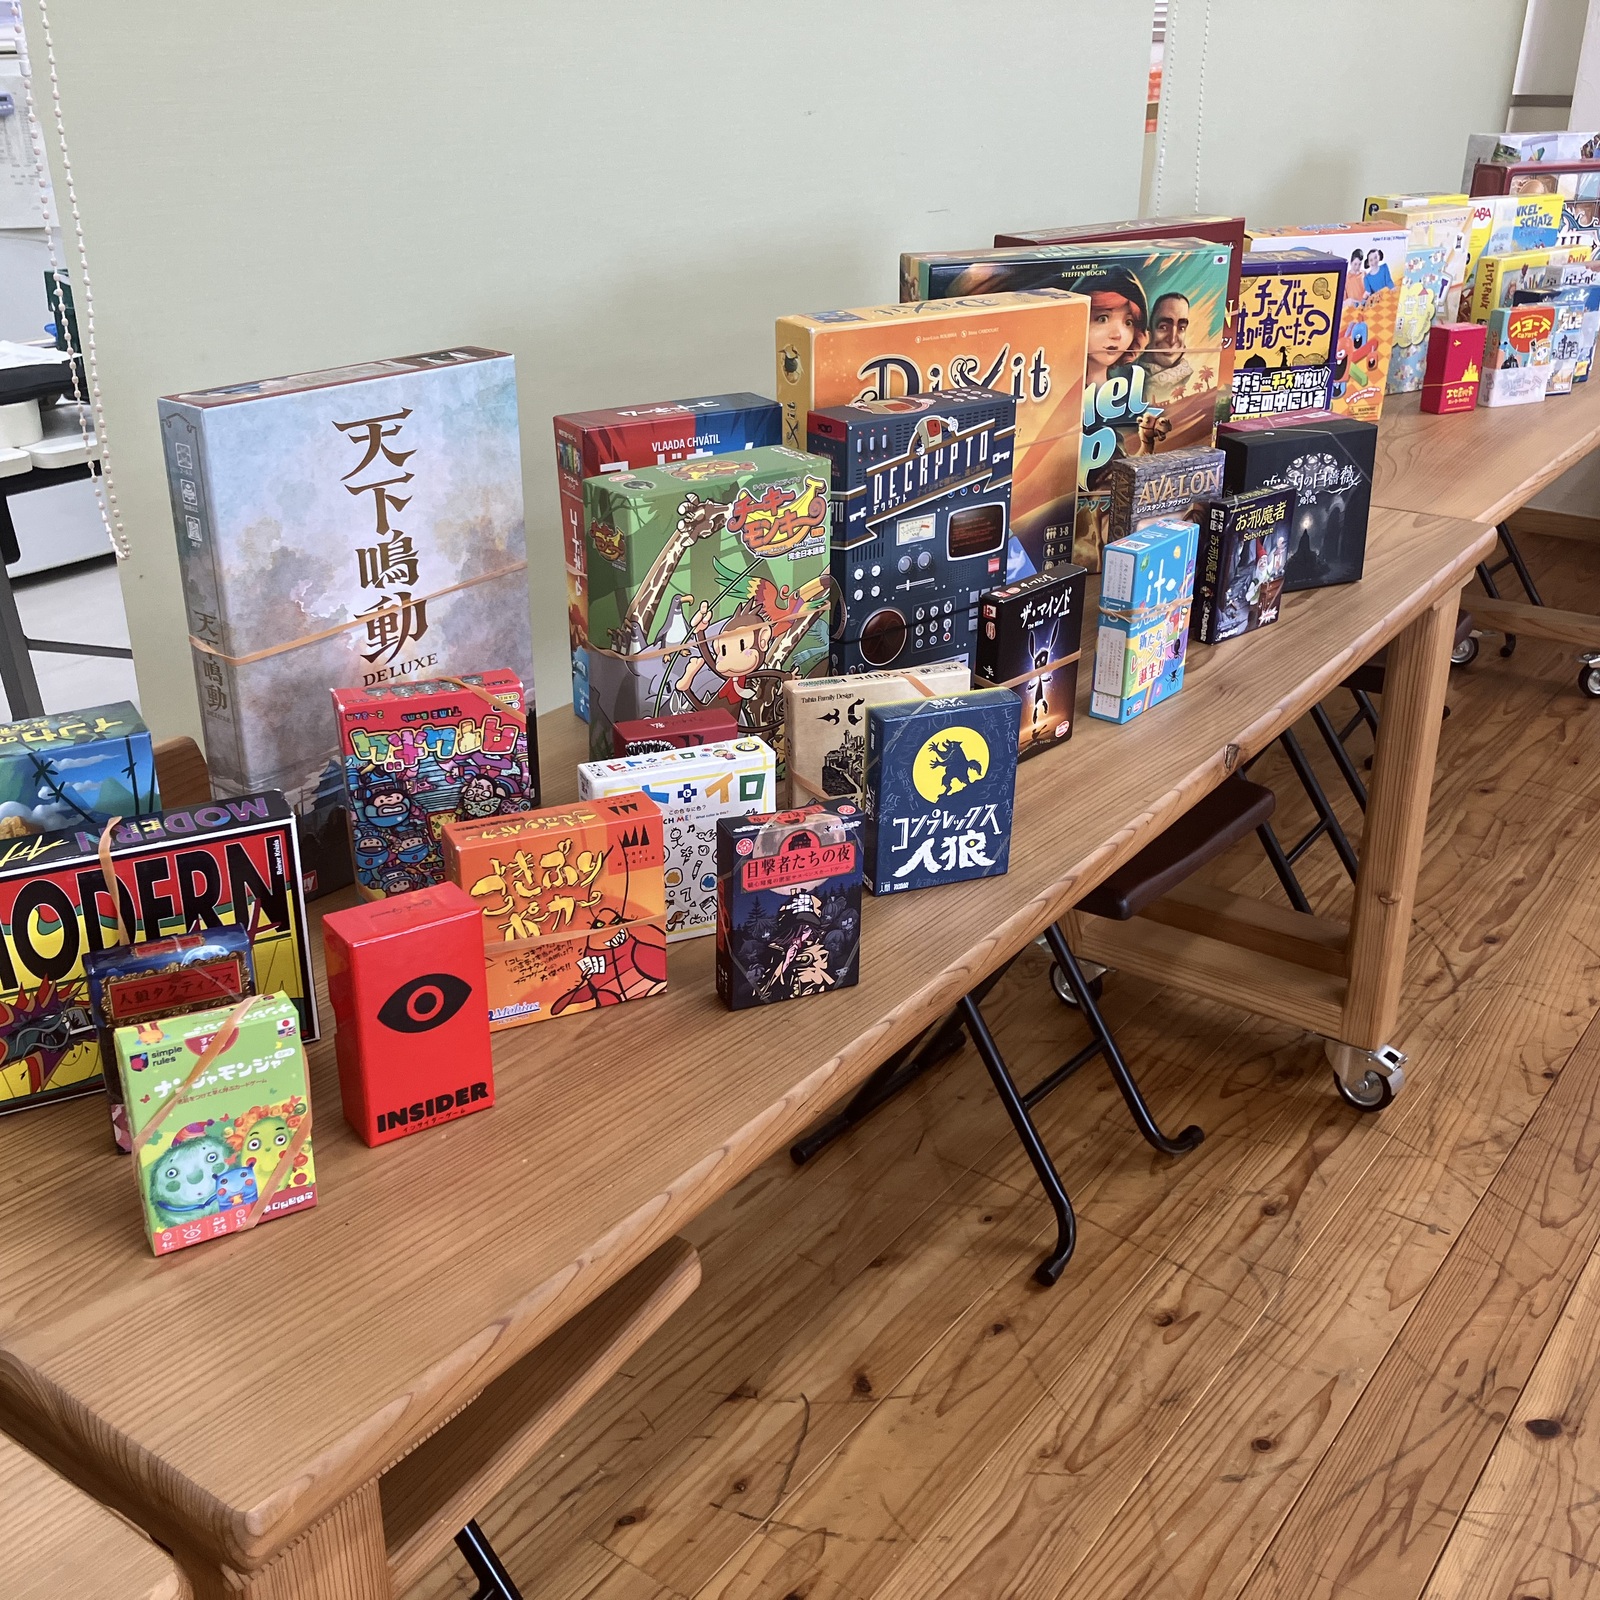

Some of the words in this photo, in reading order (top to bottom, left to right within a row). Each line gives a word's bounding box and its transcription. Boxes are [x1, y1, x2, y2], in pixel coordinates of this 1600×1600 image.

[1520, 213, 1554, 228] SCHATZ
[1061, 270, 1085, 278] STEFFEN
[1086, 268, 1108, 277] BOGEN
[1251, 279, 1315, 318] チーズは
[1510, 317, 1552, 338] コヨーテ
[855, 341, 1052, 402] Dixit
[652, 439, 686, 452] VLAADA
[687, 433, 721, 446] CHVÁTIL
[873, 430, 989, 505] DECRYPTO
[1138, 465, 1223, 506] AVALON
[873, 493, 908, 515] デクリプト
[1235, 499, 1288, 532] お邪魔者
[332, 407, 429, 666] 天下鳴動
[1059, 526, 1070, 537] 3-8
[1019, 587, 1073, 629] ザ・マインド
[1139, 629, 1163, 651] 新たな
[192, 610, 229, 712] 天下鳴動
[362, 652, 440, 688] DELUXE
[431, 706, 462, 719] TIME
[817, 693, 836, 703] Family
[836, 691, 855, 701] Design
[350, 715, 520, 773] タイムボム
[75, 797, 270, 852] MODERN
[891, 803, 1002, 853] コンプレックス
[746, 844, 851, 879] 目撃者たちの夜
[892, 829, 996, 878] 人狼
[470, 837, 604, 916] ごきぶり
[497, 890, 604, 942] ポーカー
[151, 1046, 183, 1059] simple
[152, 1055, 177, 1067] rules
[376, 1081, 490, 1133] INSIDER
